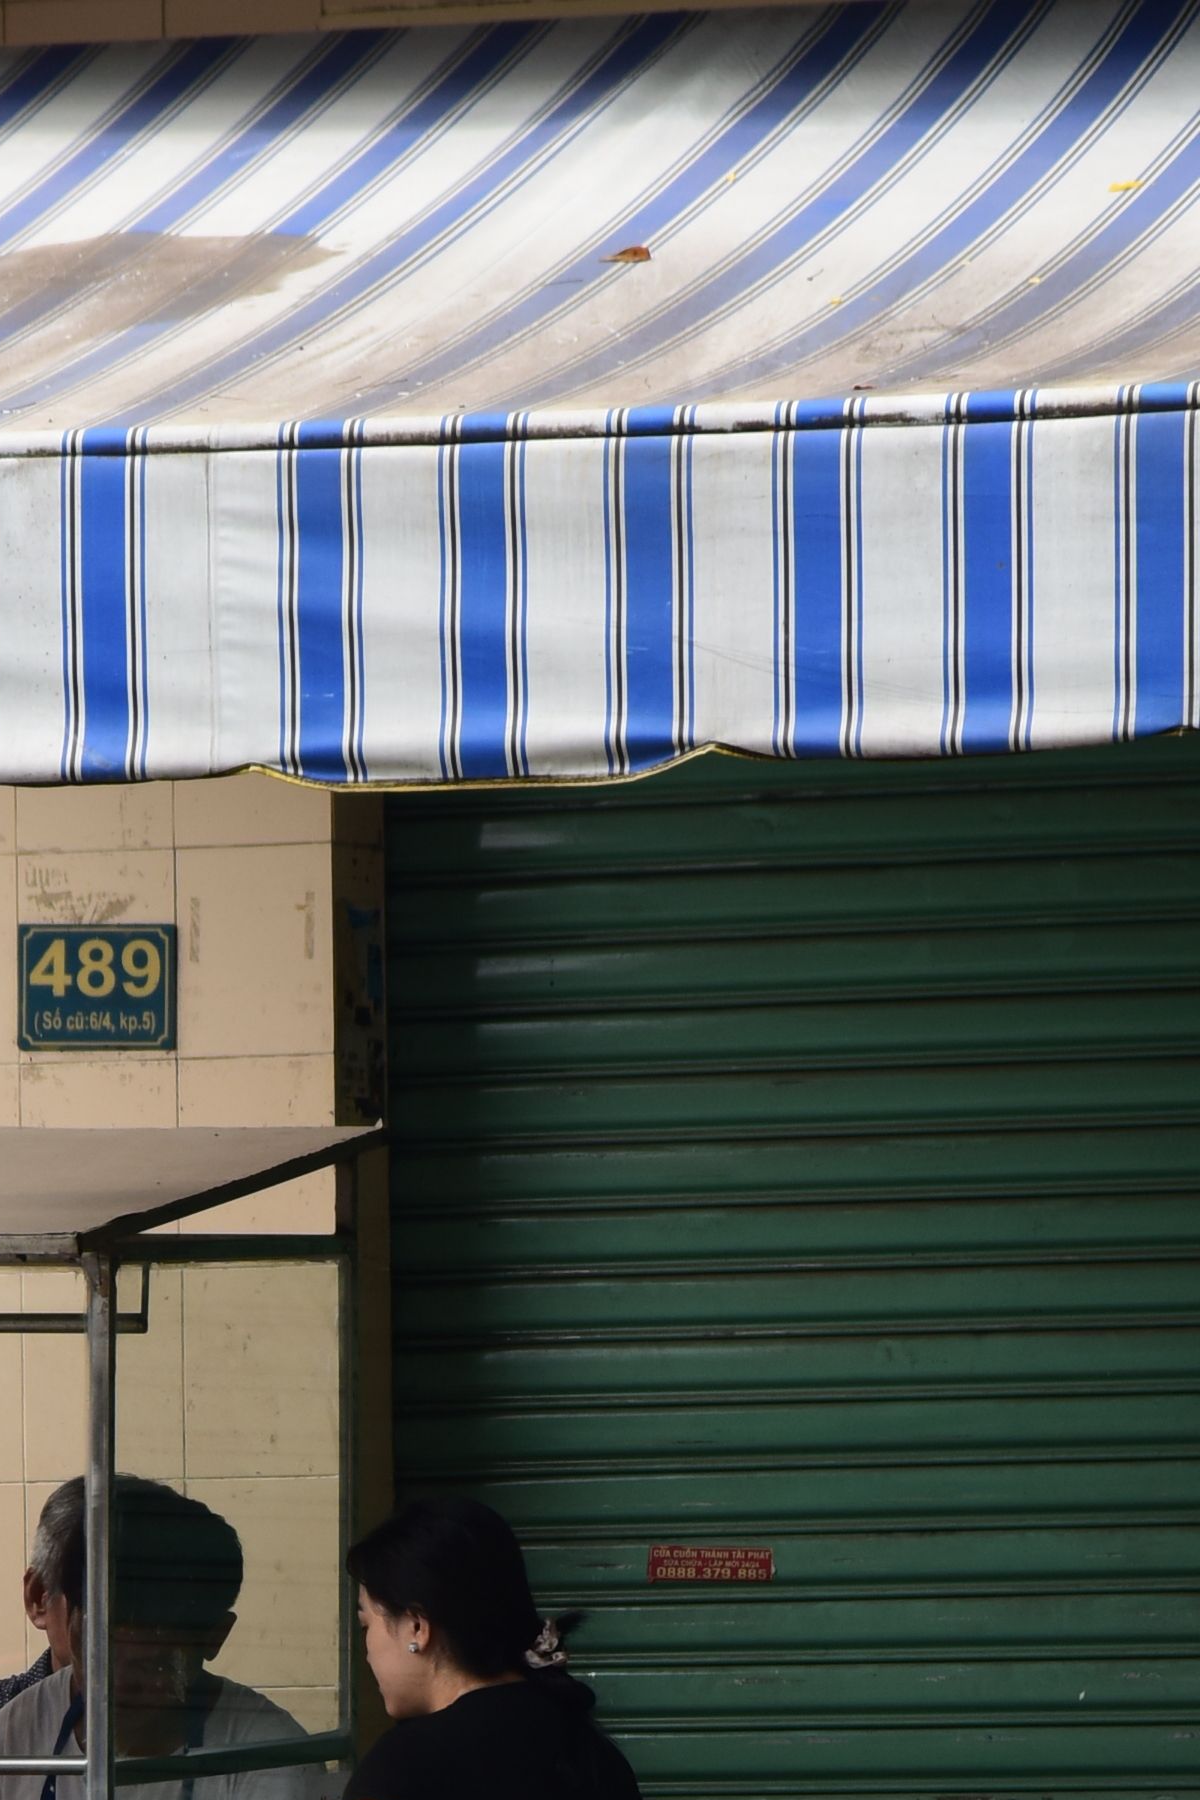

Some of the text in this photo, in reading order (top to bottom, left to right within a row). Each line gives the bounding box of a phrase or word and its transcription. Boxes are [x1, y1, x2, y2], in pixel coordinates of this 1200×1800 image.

[29, 938, 161, 998] 489
[119, 1011, 156, 1036] kp.5)
[656, 1567, 767, 1580] 0888.379.885
